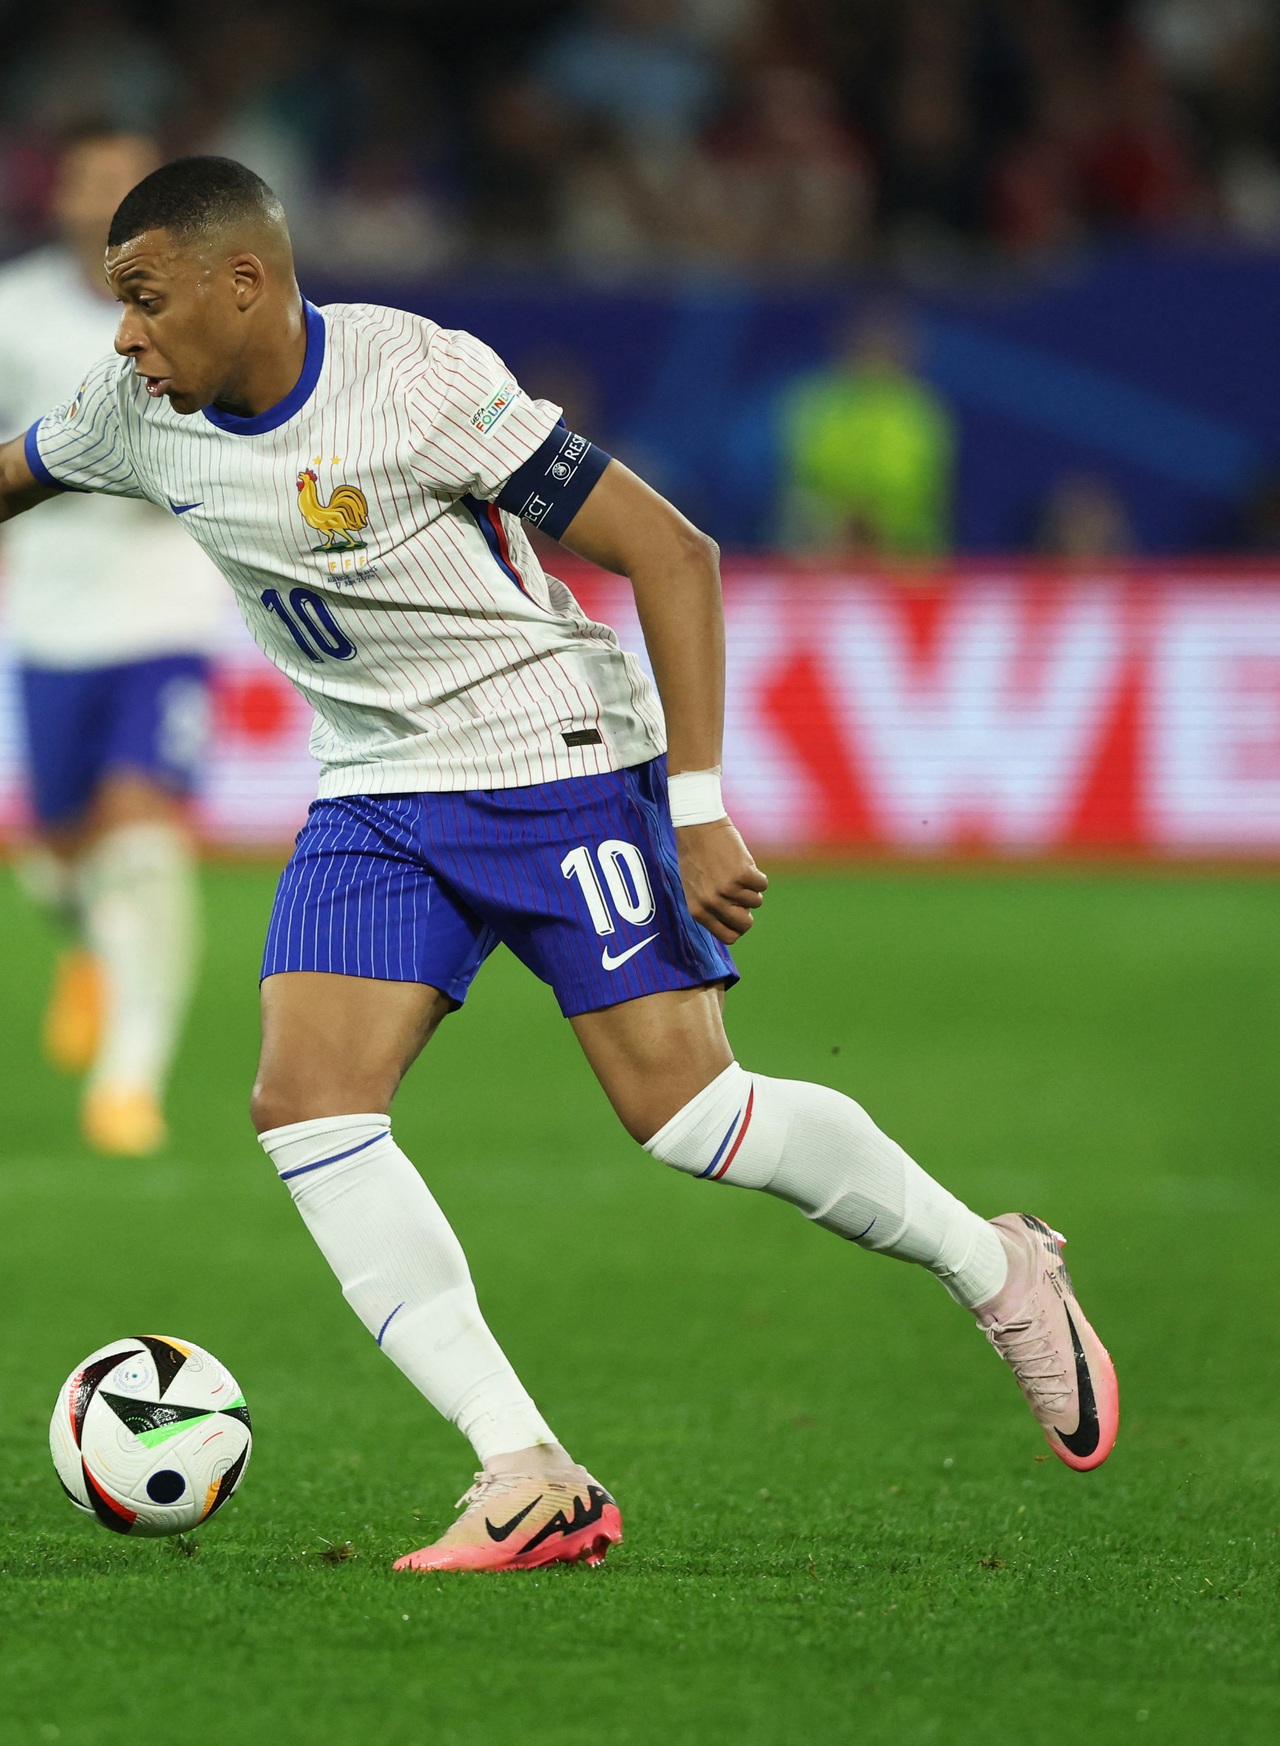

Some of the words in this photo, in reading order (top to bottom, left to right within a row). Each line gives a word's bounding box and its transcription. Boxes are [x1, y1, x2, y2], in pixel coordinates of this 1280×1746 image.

[470, 407, 486, 426] UEFA
[522, 494, 547, 523] ECT
[564, 433, 587, 461] RES
[260, 587, 357, 663] 10
[560, 839, 656, 936] 10
